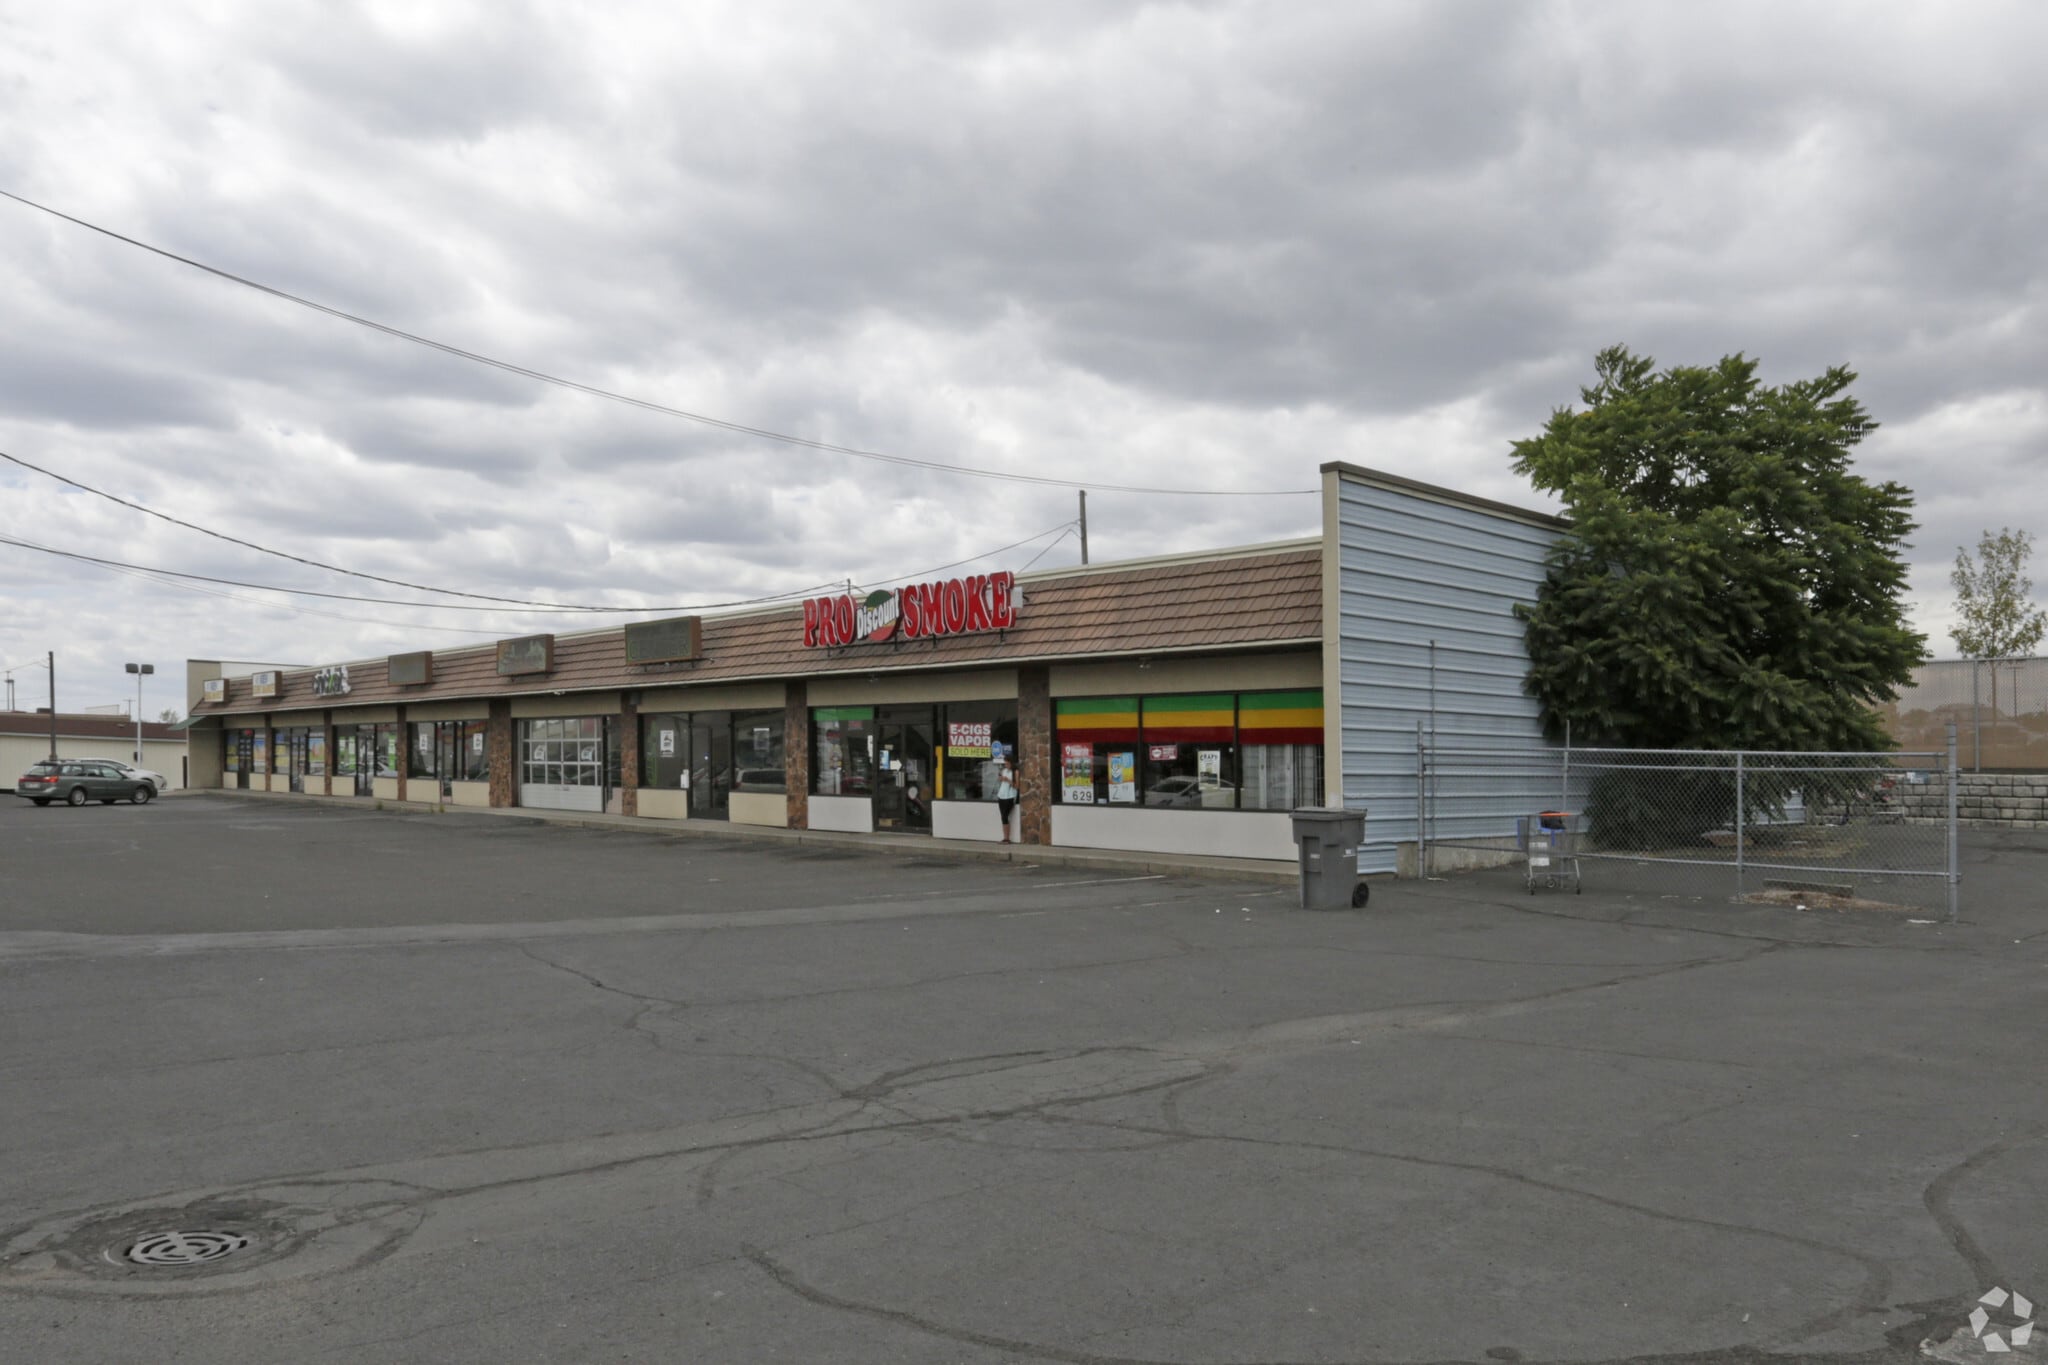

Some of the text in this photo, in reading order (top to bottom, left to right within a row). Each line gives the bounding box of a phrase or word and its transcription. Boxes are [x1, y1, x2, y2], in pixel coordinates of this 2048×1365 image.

[803, 594, 857, 647] PRO
[902, 571, 1015, 639] SMOKE
[950, 724, 991, 735] E-CIGS
[950, 735, 991, 746] VAPOR
[950, 748, 969, 756] SOLD
[971, 748, 990, 757] HERE
